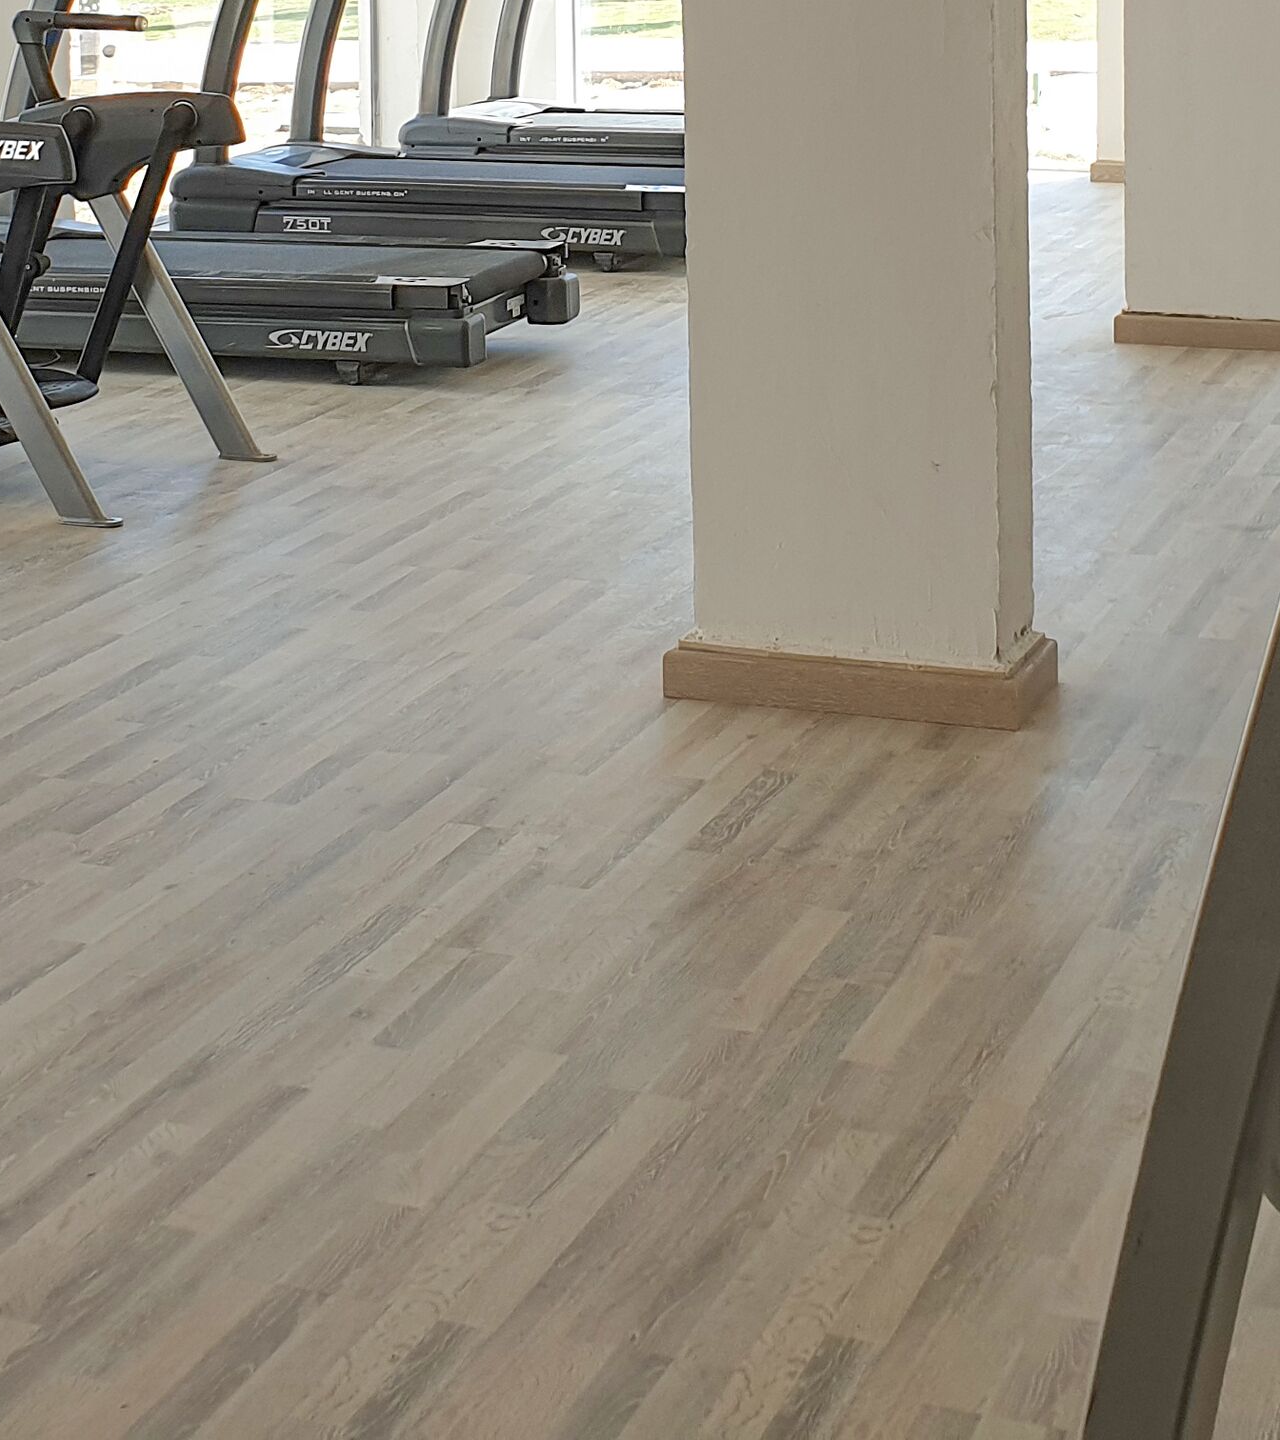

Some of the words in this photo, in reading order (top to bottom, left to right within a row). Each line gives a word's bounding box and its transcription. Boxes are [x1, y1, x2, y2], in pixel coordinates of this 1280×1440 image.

[283, 216, 332, 233] 750T
[564, 227, 626, 246] CYBEX
[299, 330, 373, 352] CYBEX
